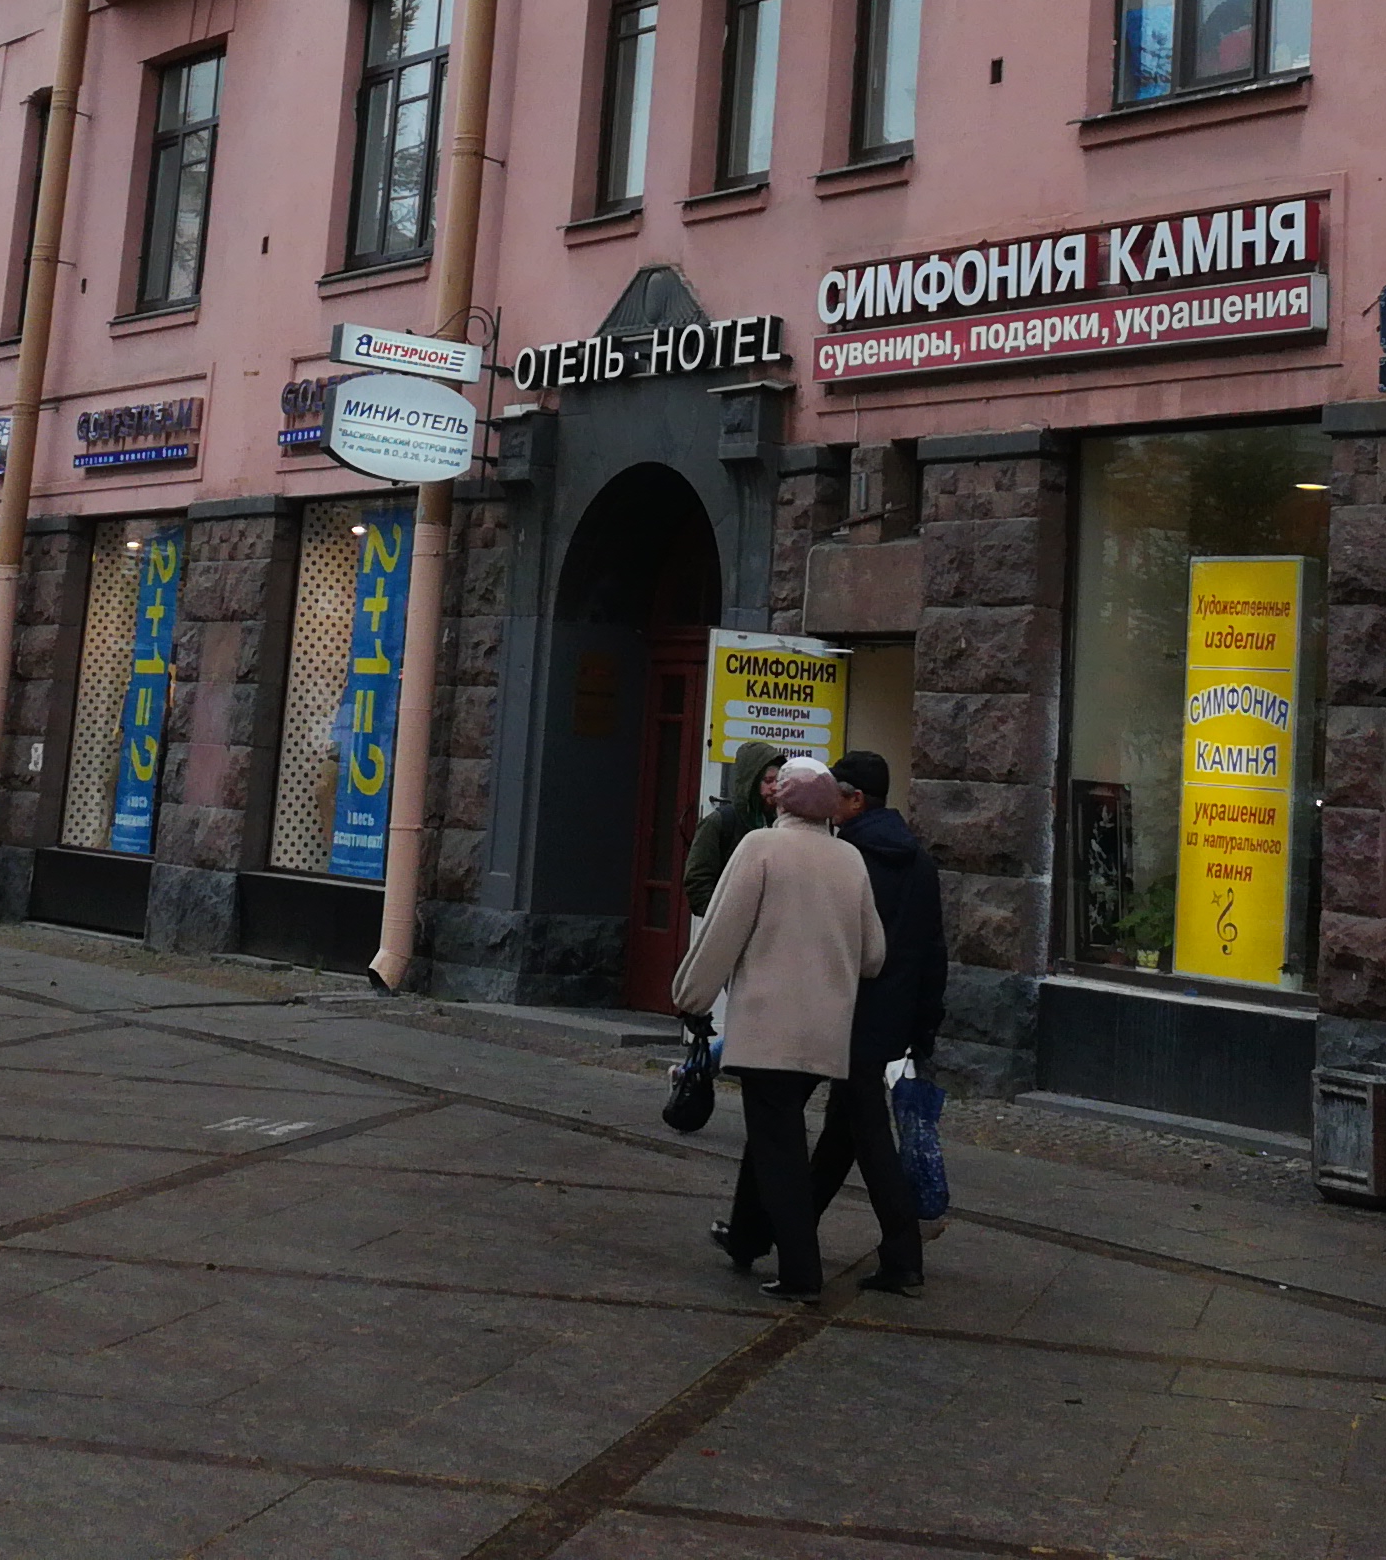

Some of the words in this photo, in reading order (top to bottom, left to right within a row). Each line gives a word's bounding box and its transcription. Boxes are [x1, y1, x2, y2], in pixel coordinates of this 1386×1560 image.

[817, 233, 1086, 325] СИМФОНИЯ
[1109, 199, 1306, 285] КАМНЯ
[818, 329, 961, 376] сувениры,
[970, 311, 1110, 353] подарки,
[1114, 286, 1308, 344] украшения
[514, 335, 624, 390] ОТЕЛЬ
[651, 314, 781, 374] HOTEL
[342, 399, 469, 435] МИНИ-ОТЕЛЬ
[1195, 594, 1291, 620] Художественные
[1204, 625, 1276, 651] изделия
[726, 653, 837, 683] СИМФОНИЯ
[746, 679, 814, 703] КАМНЯ
[747, 704, 811, 721] сувениры
[1189, 685, 1290, 731] СИМФОНИЯ
[750, 725, 805, 739] подарки
[1196, 740, 1277, 776] КАМНЯ
[1192, 802, 1276, 826] украшения
[1186, 832, 1199, 847] из
[1203, 833, 1282, 855] натурального
[1205, 862, 1253, 882] камня
